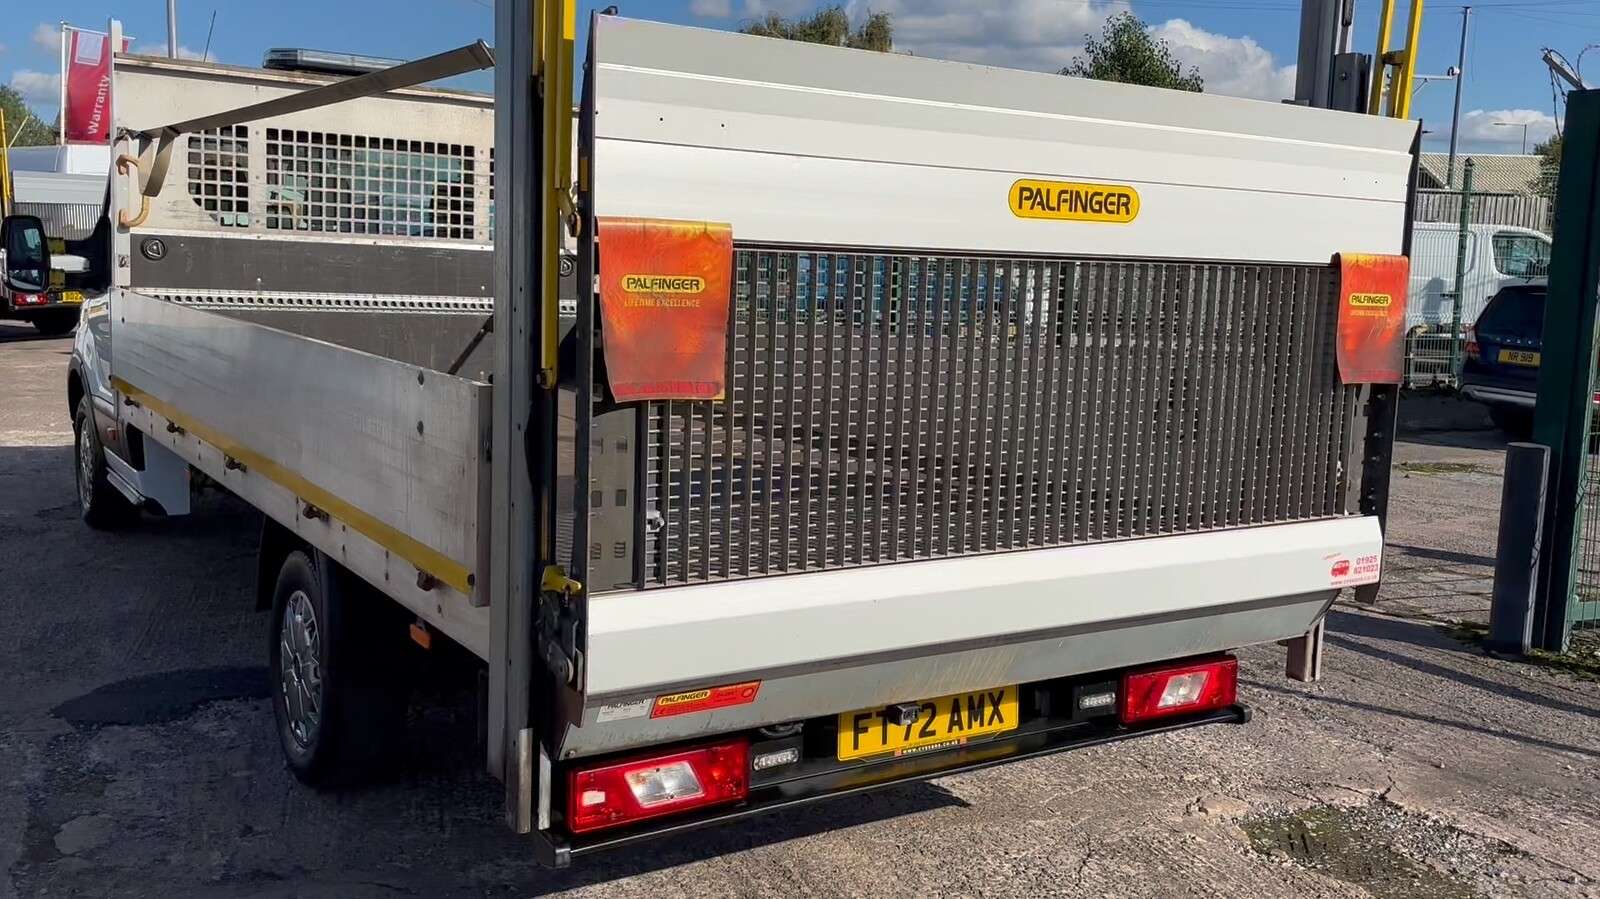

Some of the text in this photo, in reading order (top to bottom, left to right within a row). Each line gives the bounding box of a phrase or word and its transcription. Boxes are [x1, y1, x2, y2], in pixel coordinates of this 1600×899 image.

[88, 75, 110, 134] Warranty
[1018, 185, 1132, 217] PALFINGER
[627, 277, 700, 291] PALFINGER
[656, 298, 700, 308] EXCELLENCE
[1351, 294, 1390, 305] PALFINGER
[1356, 555, 1378, 565] 01925
[660, 690, 708, 705] PALFINGER
[947, 690, 1004, 733] AMX
